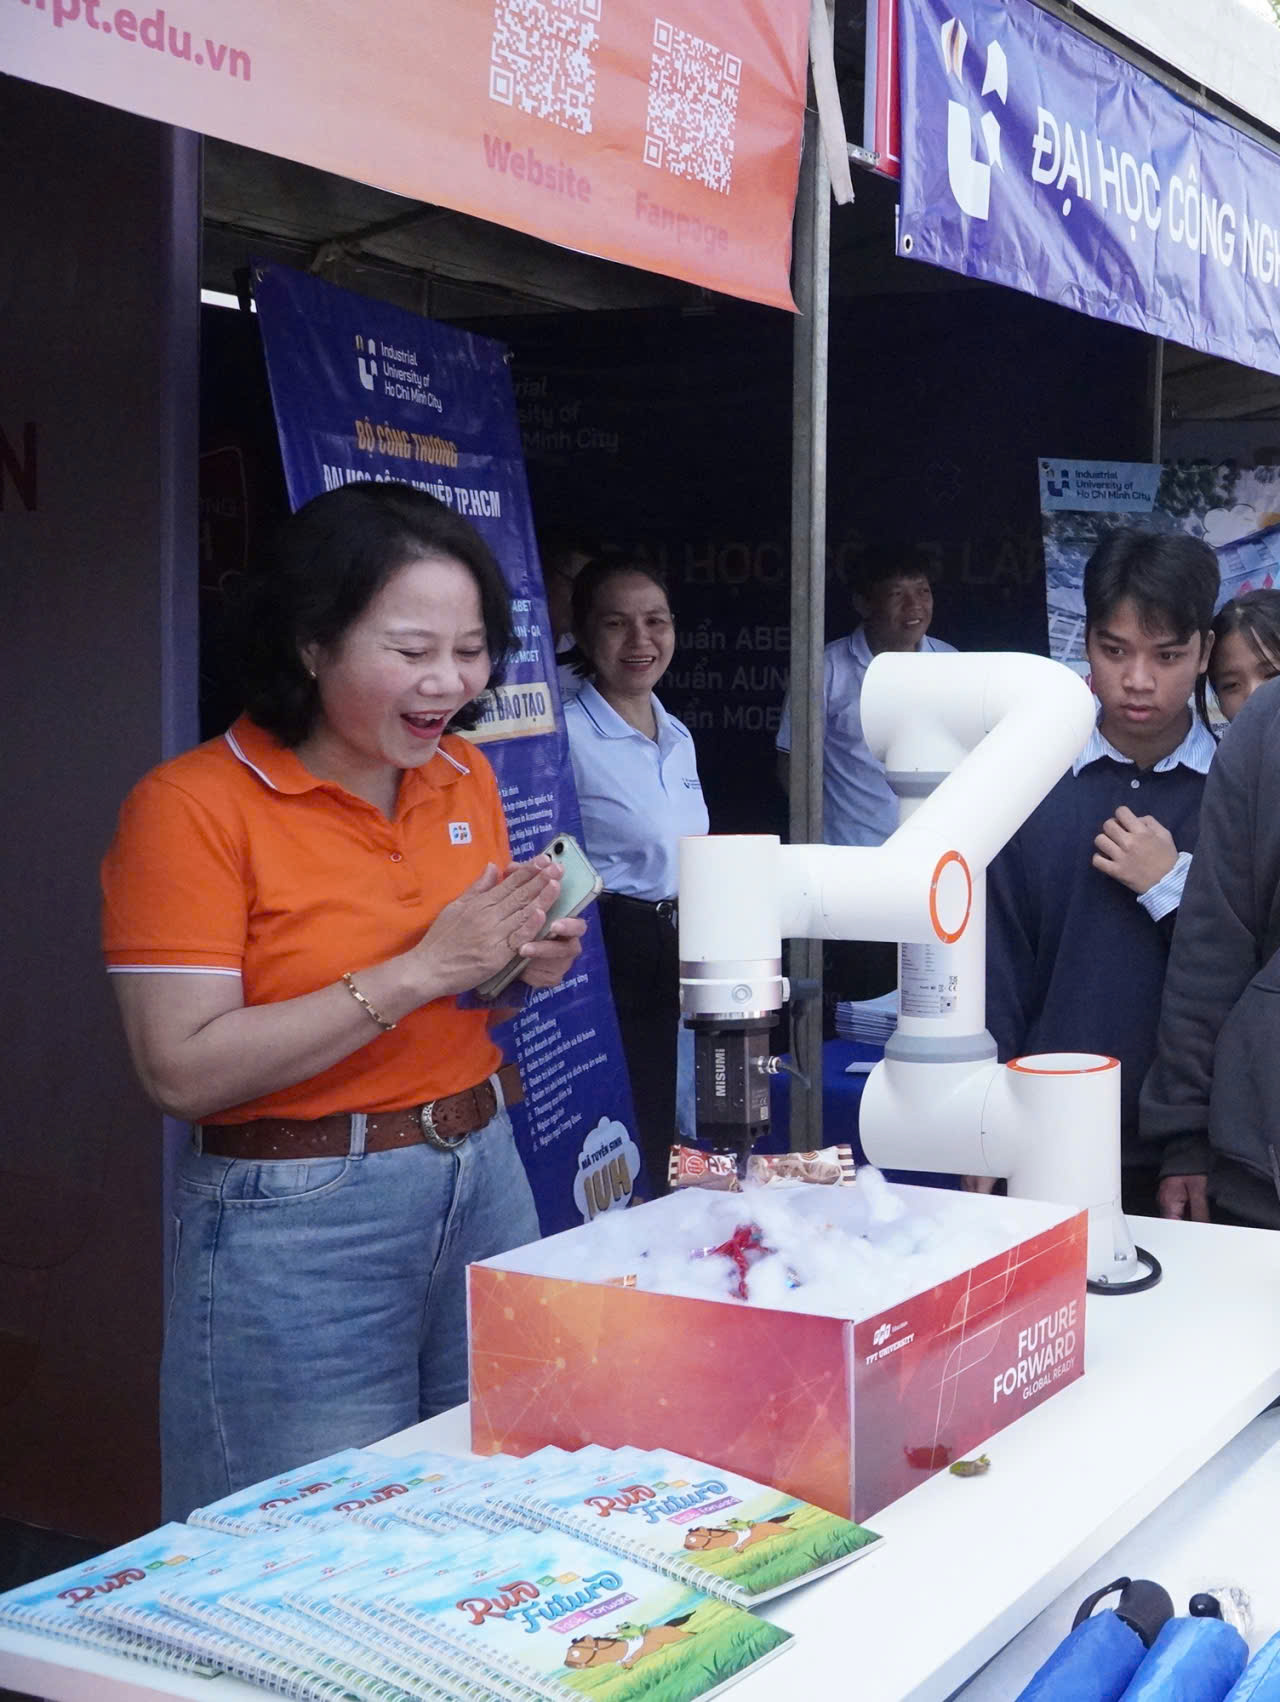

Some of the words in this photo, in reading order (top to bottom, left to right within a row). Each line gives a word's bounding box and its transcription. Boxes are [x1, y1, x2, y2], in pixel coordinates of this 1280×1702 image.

[18, 0, 251, 81] pt.edu.vn
[483, 133, 592, 203] Website
[1031, 105, 1092, 216] ĐẠI
[1096, 138, 1162, 241] HỌC
[1169, 162, 1236, 267] CÔNG
[634, 190, 729, 252] Fanpage
[381, 341, 418, 366] Industrial
[383, 360, 422, 388] University
[423, 374, 430, 387] of
[385, 380, 395, 397] Ho
[395, 384, 411, 400] Chi
[411, 387, 428, 405] Minh
[427, 392, 443, 413] City
[355, 416, 374, 459] BỘ
[376, 421, 412, 460] CÔNG
[1074, 470, 1118, 479] Industrial
[1076, 480, 1123, 491] University
[1124, 481, 1134, 490] of
[454, 487, 502, 517] TP.HCM
[1076, 489, 1090, 499] Ho
[1092, 490, 1107, 499] Chi
[1108, 490, 1131, 500] Minh
[1132, 491, 1152, 502] City
[512, 600, 532, 612] ABET
[735, 627, 791, 650] ABE
[521, 691, 546, 722] TẠO
[715, 1048, 726, 1097] MISUMI
[609, 1136, 623, 1152] SINH
[584, 1152, 632, 1221] IUH
[1018, 1299, 1077, 1358] FUTURE
[993, 1330, 1076, 1404] FORWARD
[1022, 1373, 1052, 1400] GLOBAL
[1053, 1357, 1075, 1379] READY
[584, 1484, 656, 1517] Run
[456, 1580, 540, 1625] Run
